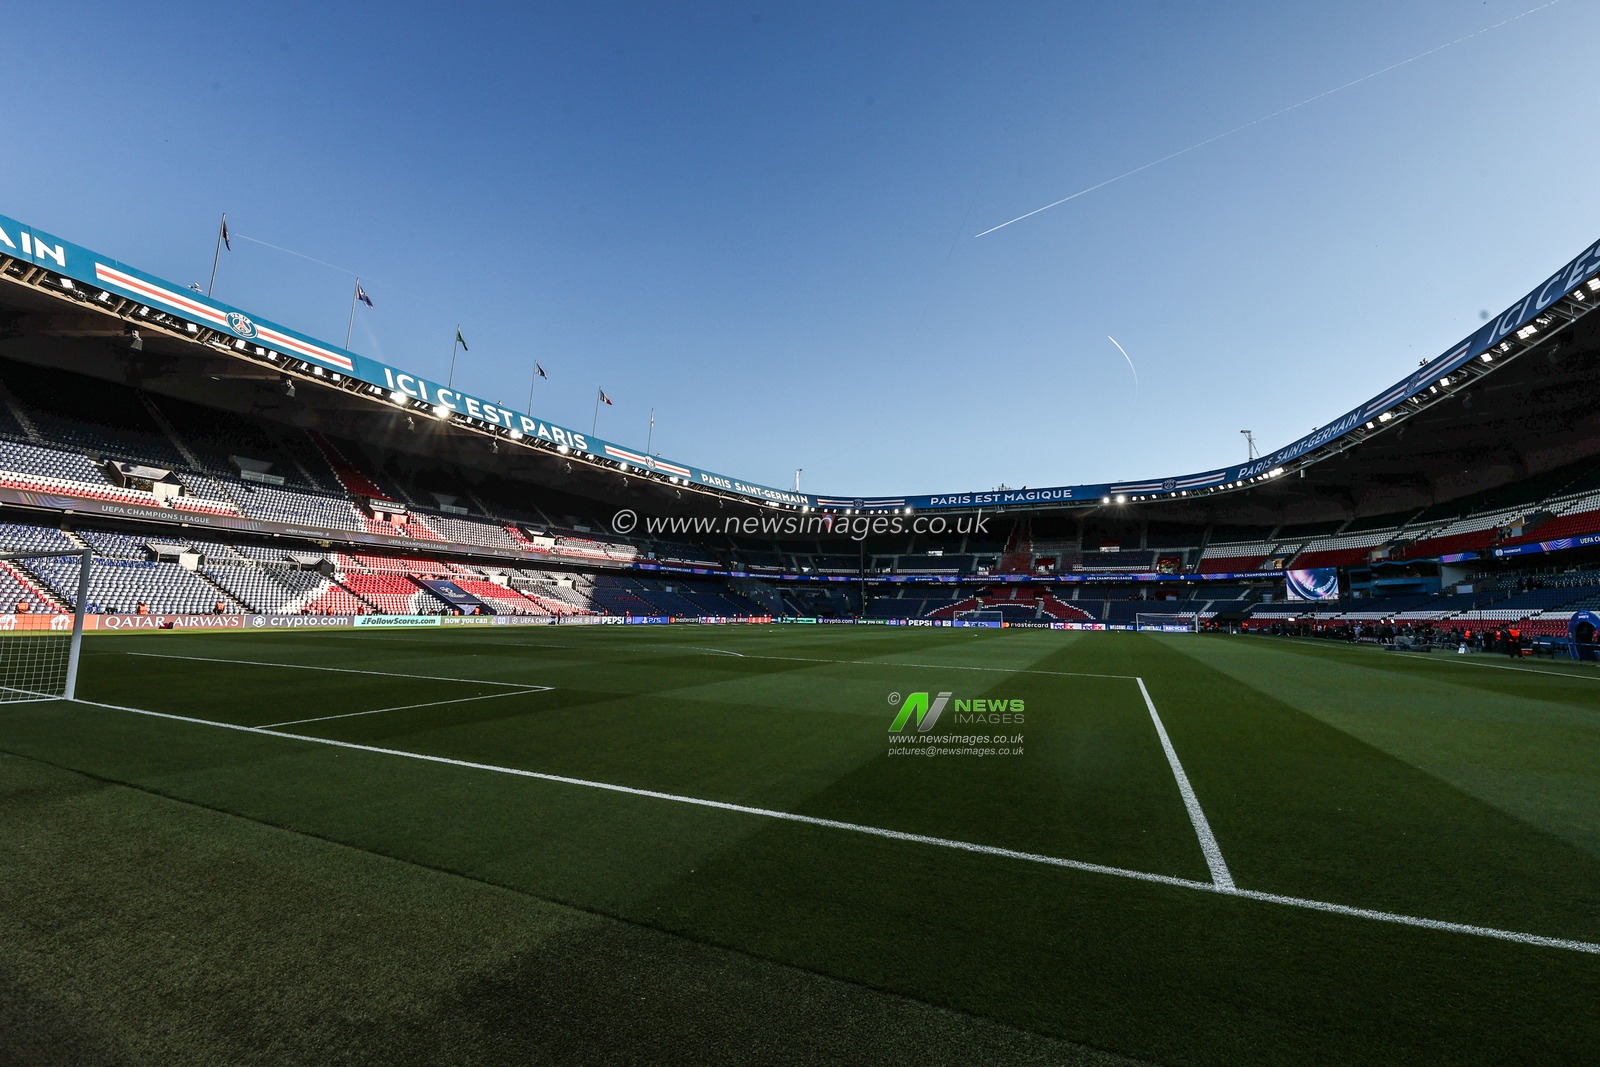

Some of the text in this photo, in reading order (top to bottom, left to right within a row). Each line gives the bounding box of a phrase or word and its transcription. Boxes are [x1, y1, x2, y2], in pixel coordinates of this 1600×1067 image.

[1487, 294, 1532, 345] ICI
[384, 367, 588, 450] ICI C'EST PARIS
[1238, 409, 1361, 478] PARIS SAINT-GERMAIN
[700, 473, 809, 504] PARIS SAINT-GERMAIN
[930, 489, 1072, 505] PARIS EST MAGIQUE
[101, 505, 210, 524] UEFA CHAMPIONS LEAGUE
[402, 540, 430, 548] CHAMPIONS
[105, 616, 239, 629] QATAR AIRWAYS
[270, 615, 348, 628] crypto.com
[460, 617, 474, 627] you
[602, 616, 625, 624] PEPSI
